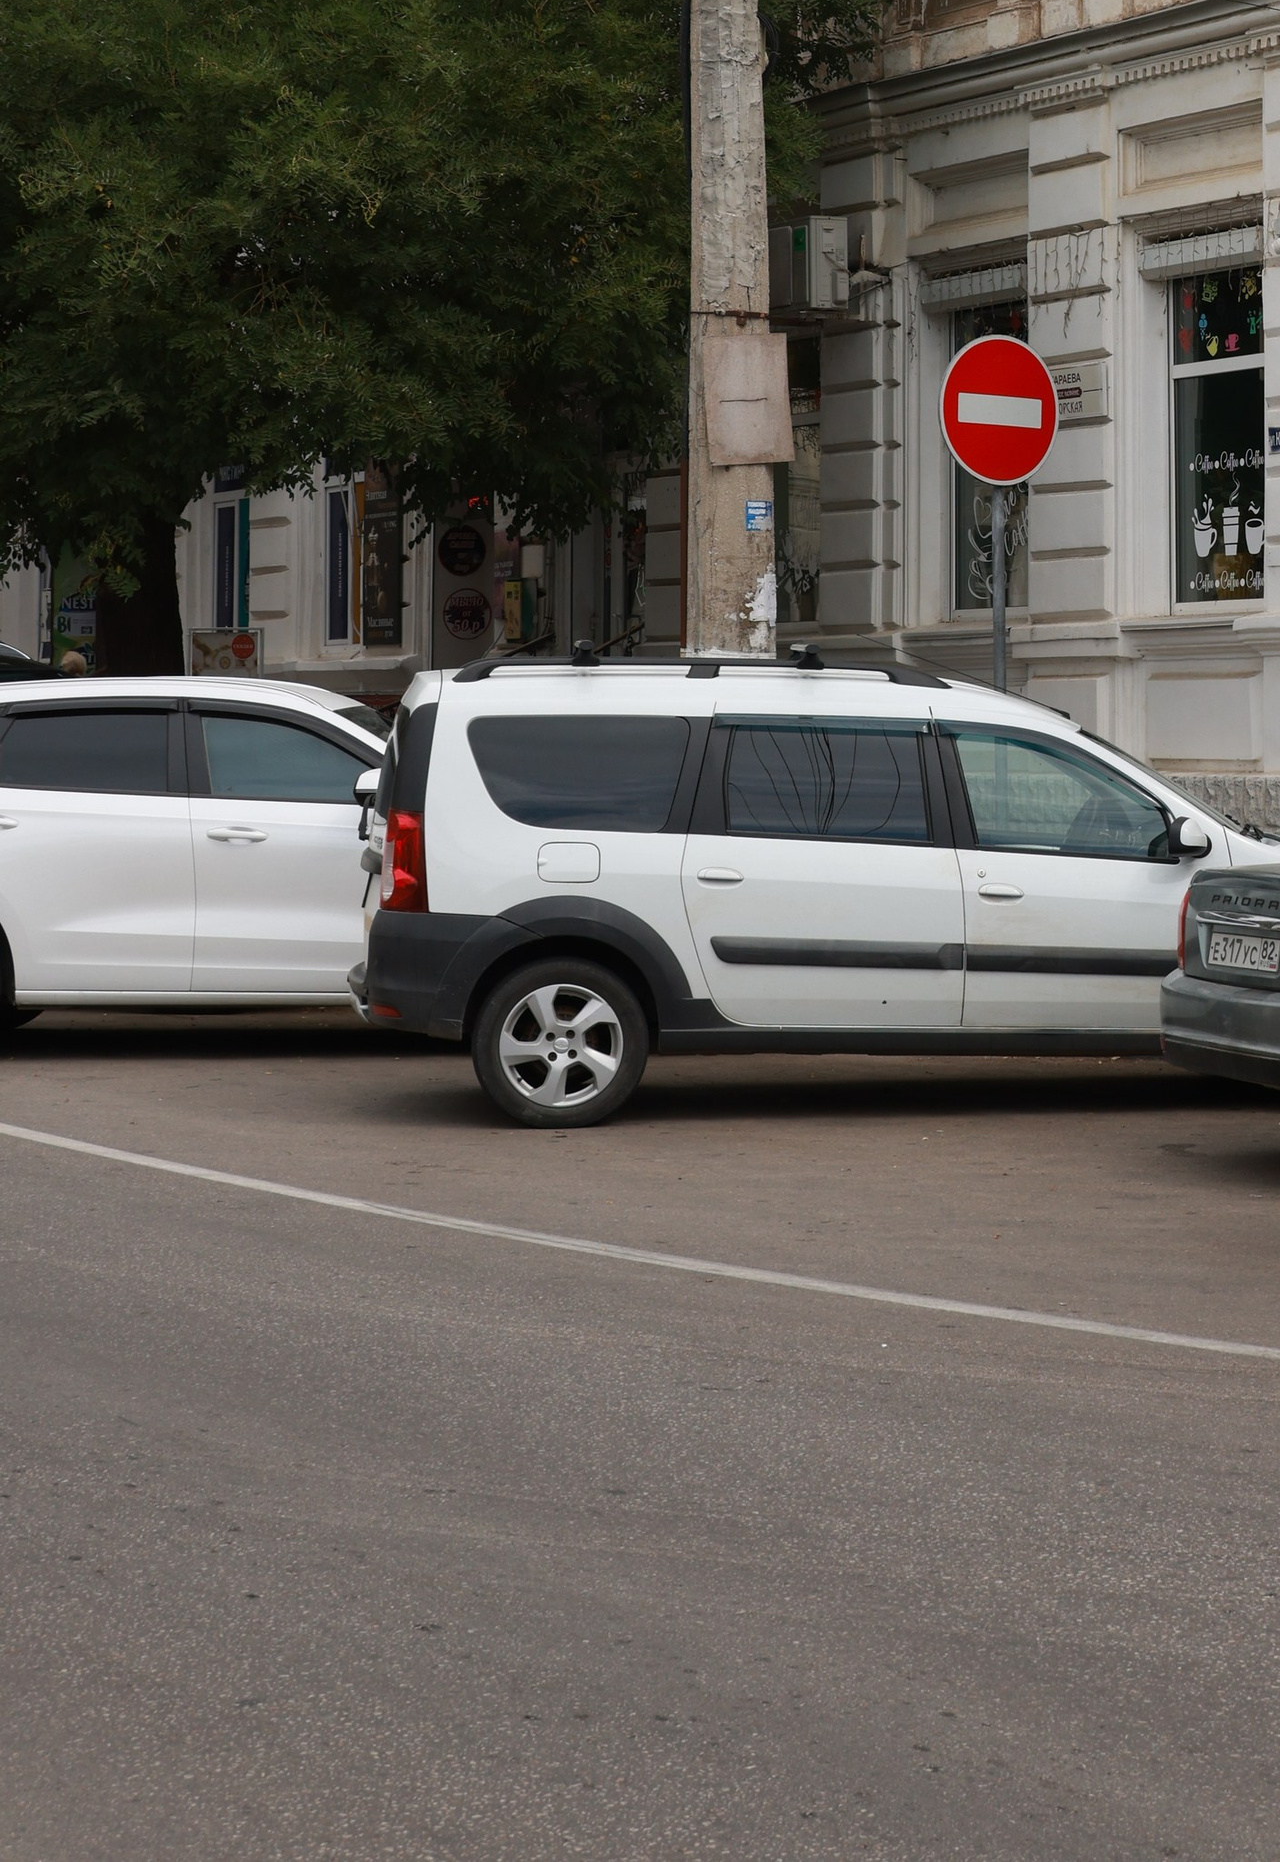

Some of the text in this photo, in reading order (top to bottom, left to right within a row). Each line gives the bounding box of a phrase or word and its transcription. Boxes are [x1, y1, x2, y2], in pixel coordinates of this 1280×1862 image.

[1052, 373, 1081, 385] АРАЕВА
[1195, 453, 1213, 474] Coffee
[1220, 450, 1239, 472] Coffee
[1195, 571, 1213, 592] Coffee
[1220, 570, 1239, 592] Coffee
[450, 596, 484, 607] МЫЛО
[452, 619, 469, 632] 50
[1211, 894, 1280, 910] PRIORA
[1212, 937, 1276, 965] Е317УС 82
